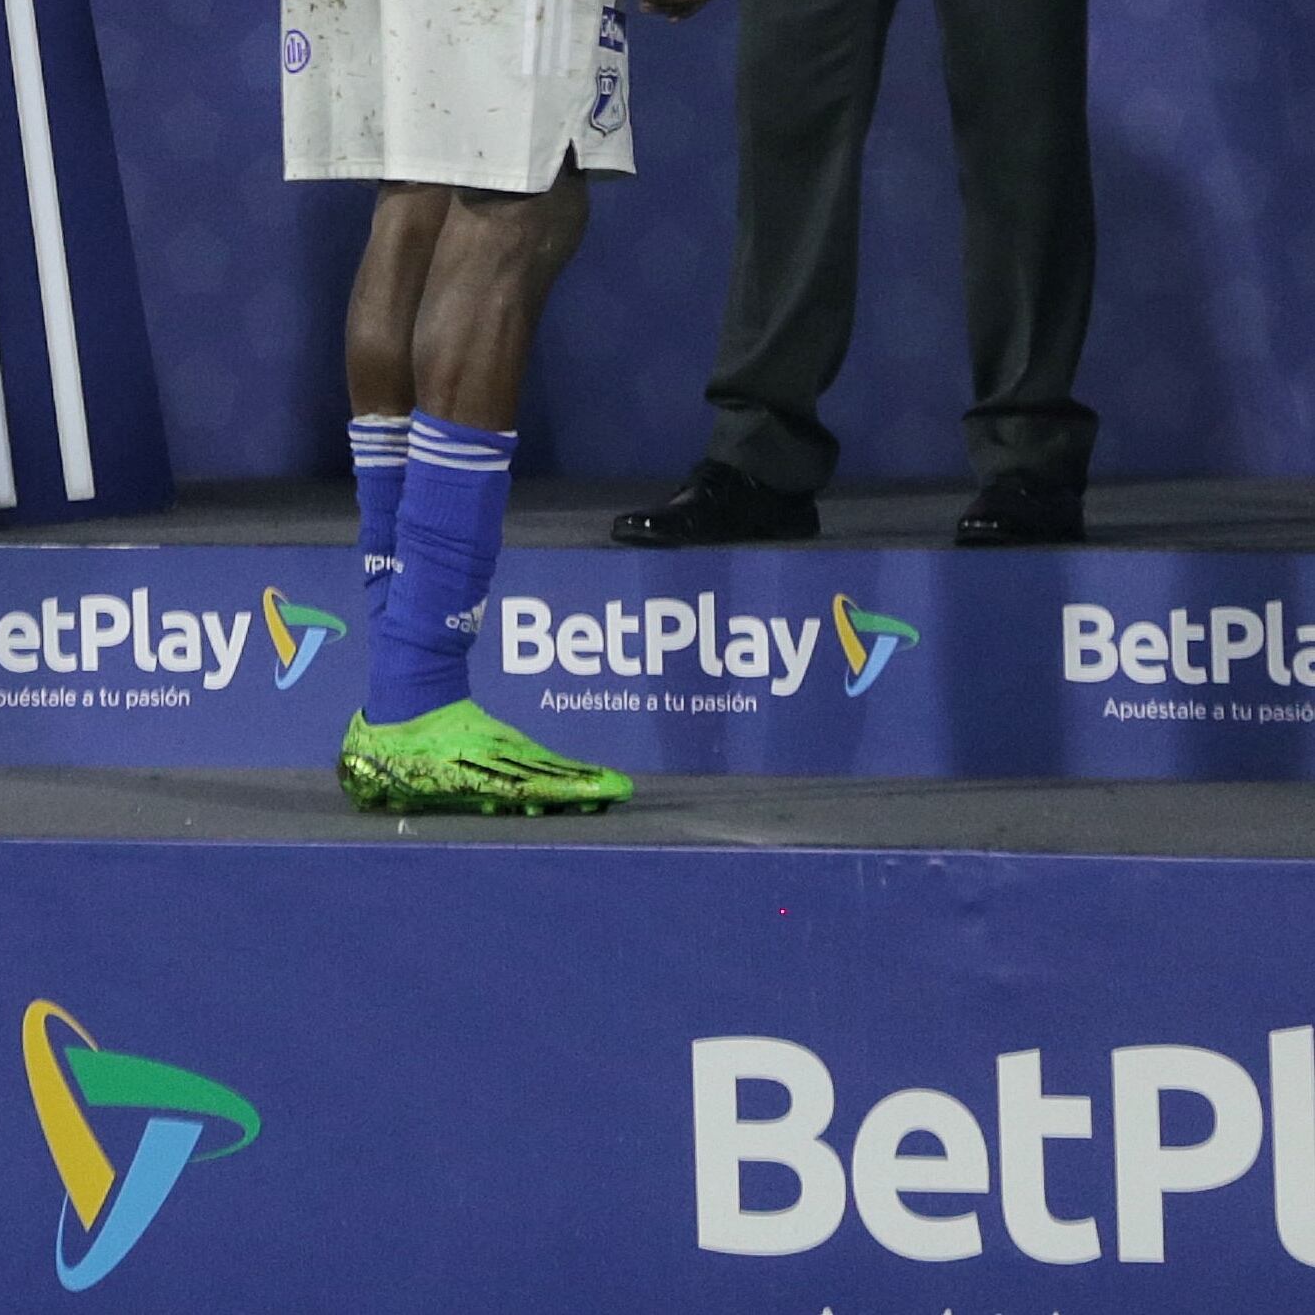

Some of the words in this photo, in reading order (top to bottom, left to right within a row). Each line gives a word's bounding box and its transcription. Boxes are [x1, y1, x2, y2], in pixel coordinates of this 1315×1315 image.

[501, 591, 821, 696] BetPlay
[1062, 601, 1315, 686] BetPla
[82, 690, 94, 707] a
[99, 688, 120, 707] tu
[126, 686, 191, 710] pasión
[540, 688, 640, 714] Apuéstale
[646, 694, 658, 711] a
[664, 692, 685, 712] tu
[691, 692, 757, 715] pasión
[1102, 696, 1206, 722] Apuéstale
[1212, 704, 1225, 720] a
[1231, 702, 1252, 721] tu
[1259, 700, 1315, 724] pasió
[691, 1025, 1315, 1268] BetPl
